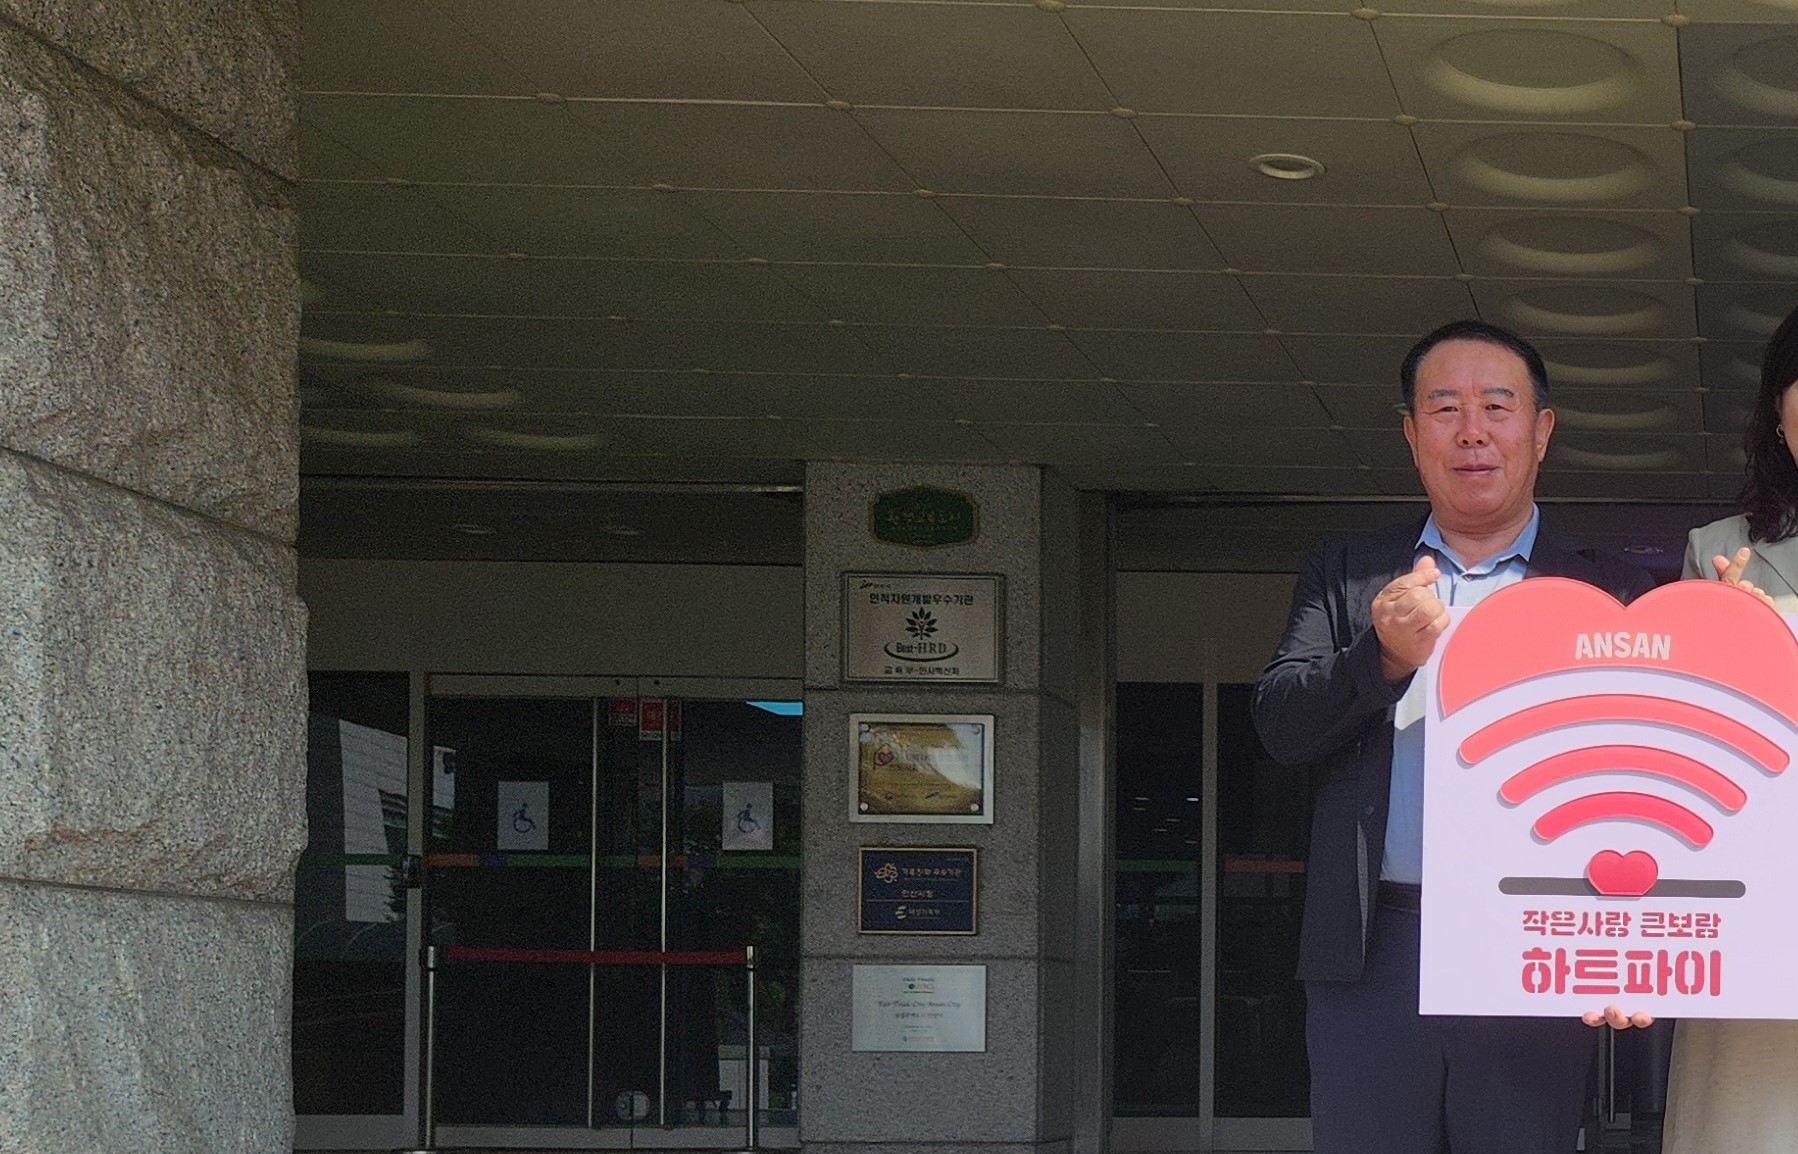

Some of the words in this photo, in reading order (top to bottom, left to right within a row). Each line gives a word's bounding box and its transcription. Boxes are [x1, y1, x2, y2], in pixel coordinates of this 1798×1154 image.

[1575, 632, 1671, 660] ANSAN
[1522, 910, 1630, 937] 작은사랑
[1640, 911, 1721, 938] 큰보람
[1522, 947, 1722, 997] 하트파이
